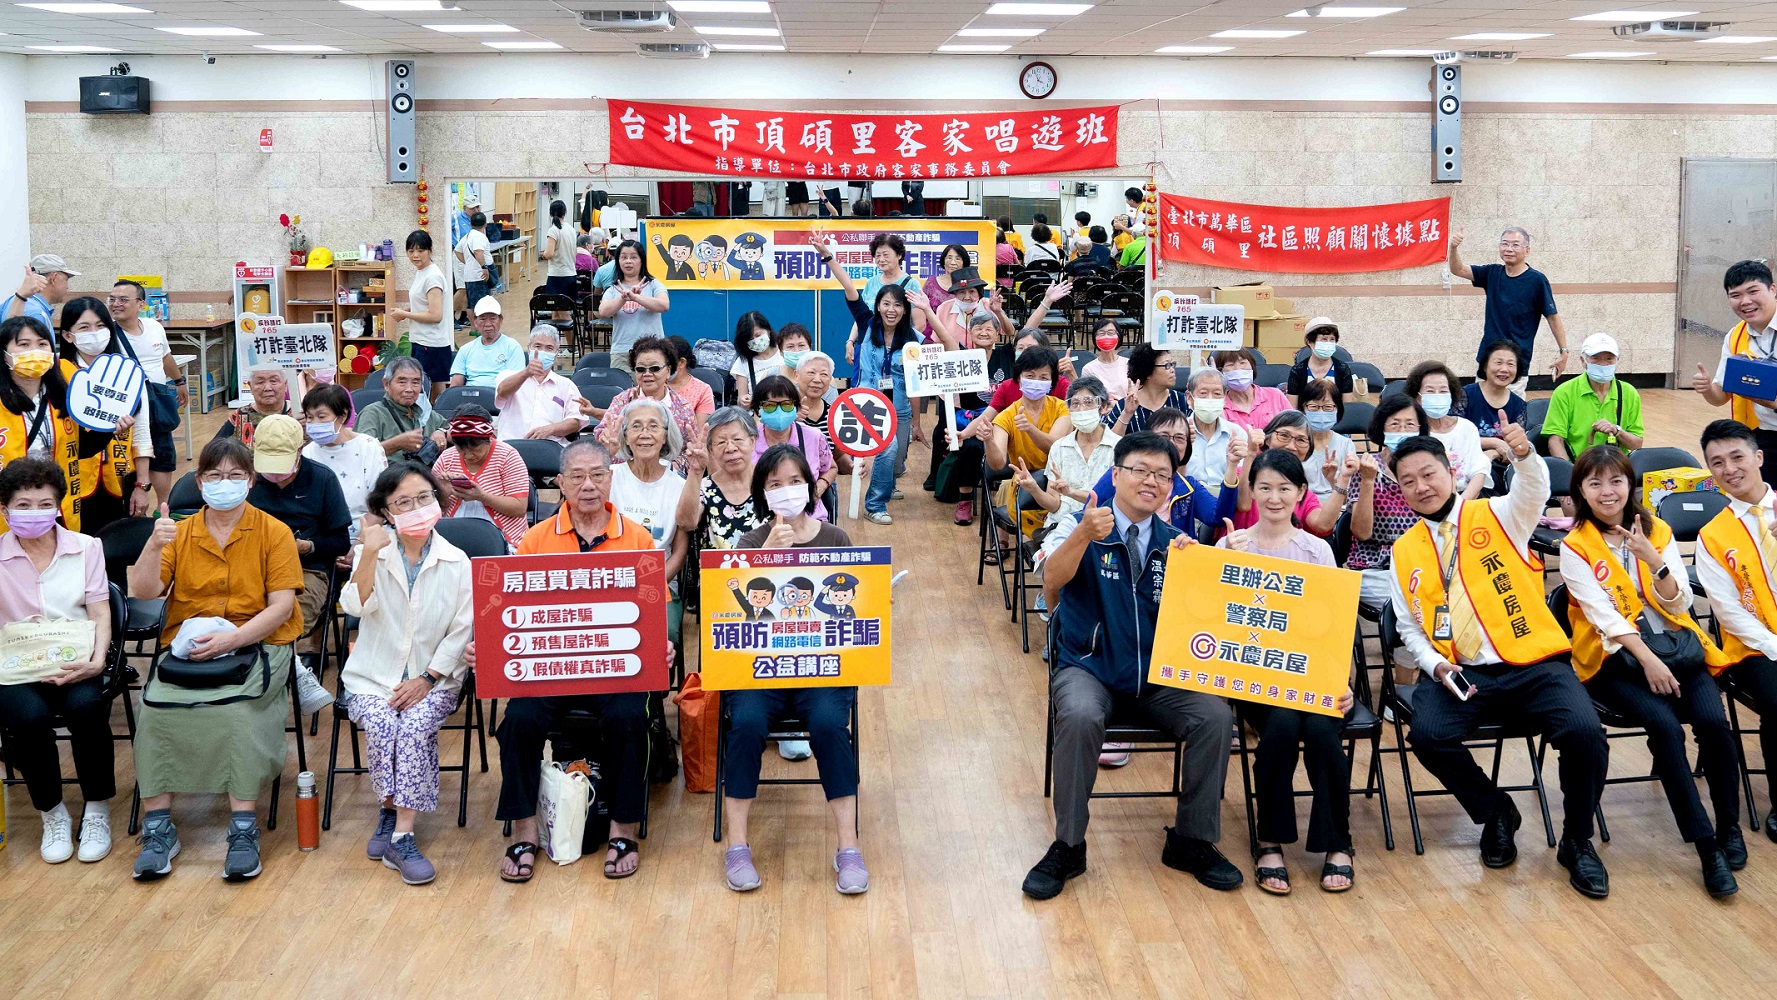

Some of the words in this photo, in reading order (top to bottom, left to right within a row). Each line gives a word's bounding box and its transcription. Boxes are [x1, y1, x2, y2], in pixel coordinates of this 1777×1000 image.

[620, 106, 1109, 158] 台北市頂碩里客家唱遊班
[1167, 205, 1253, 234] 臺北市萬華區
[1258, 218, 1440, 251] 社區照顧關懷據點
[836, 251, 874, 264] 房屋買
[1166, 315, 1238, 334] 打詐臺北隊
[253, 335, 328, 355] 打詐臺北隊
[917, 359, 983, 380] 打詐臺北隊
[752, 553, 795, 565] 公私聯手
[799, 551, 872, 564] 防範不動產詐騙
[502, 566, 636, 593] 房屋買賣詐騙
[1220, 563, 1304, 597] 里辦公室
[1480, 550, 1532, 639] 永慶房屋
[506, 608, 518, 624] 1
[531, 607, 593, 625] 成屋詐騙
[771, 621, 822, 634] 房屋買賣
[1226, 602, 1288, 632] 警察局
[508, 635, 521, 651] 2
[531, 632, 610, 651] 預售屋詐騙
[712, 621, 769, 649] 預防
[771, 635, 822, 648] 網路電信
[825, 618, 880, 647] 詐騙
[509, 661, 523, 677] 3
[532, 658, 626, 677] 假債權真詐騙
[753, 655, 839, 678] 公益講座
[1219, 641, 1308, 674] 永慶房屋
[1160, 665, 1334, 708] 攜手守護您的身家財產
